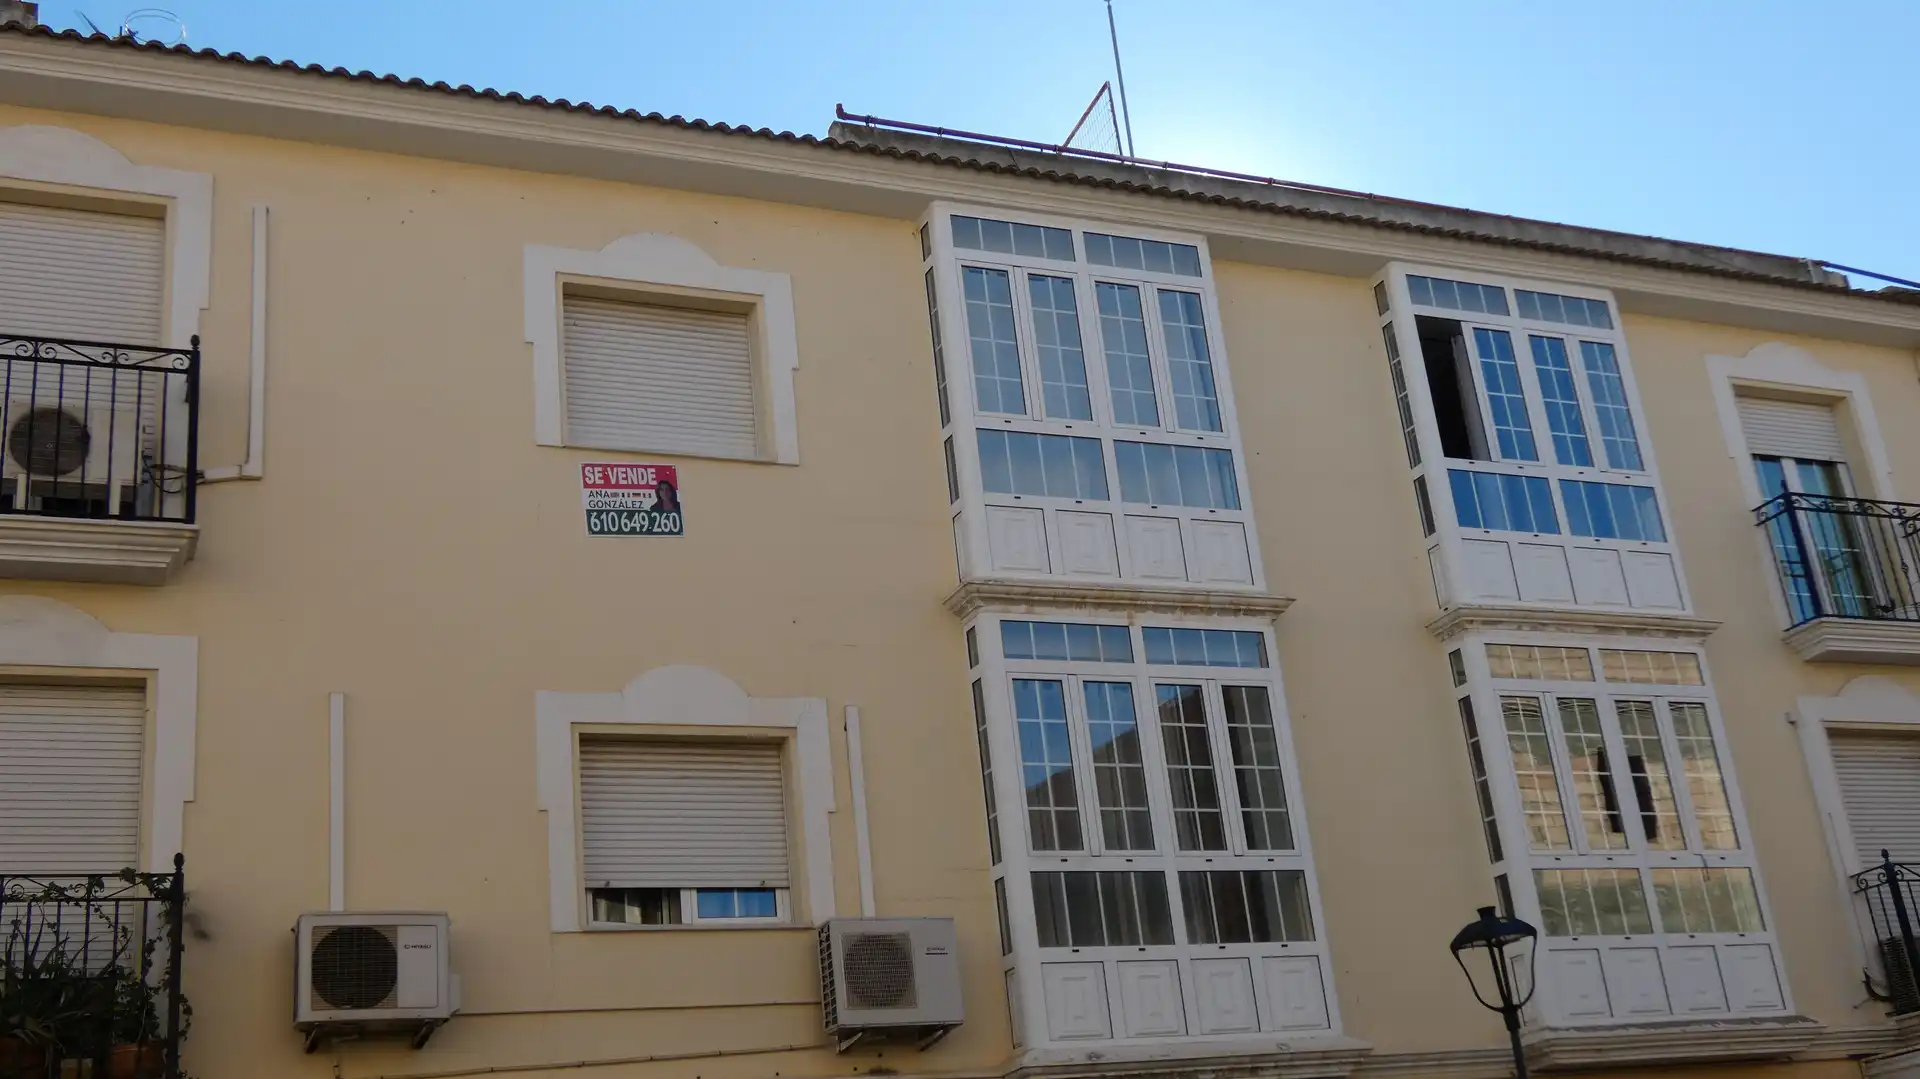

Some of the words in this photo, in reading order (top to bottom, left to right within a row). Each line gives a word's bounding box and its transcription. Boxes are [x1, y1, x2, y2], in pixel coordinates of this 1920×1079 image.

[584, 466, 604, 484] SE
[607, 467, 657, 485] VENDE
[588, 490, 611, 499] ANA
[588, 499, 644, 509] GONZÁLEZ
[590, 512, 619, 532] 610
[620, 512, 648, 532] 649
[651, 512, 680, 533] 260
